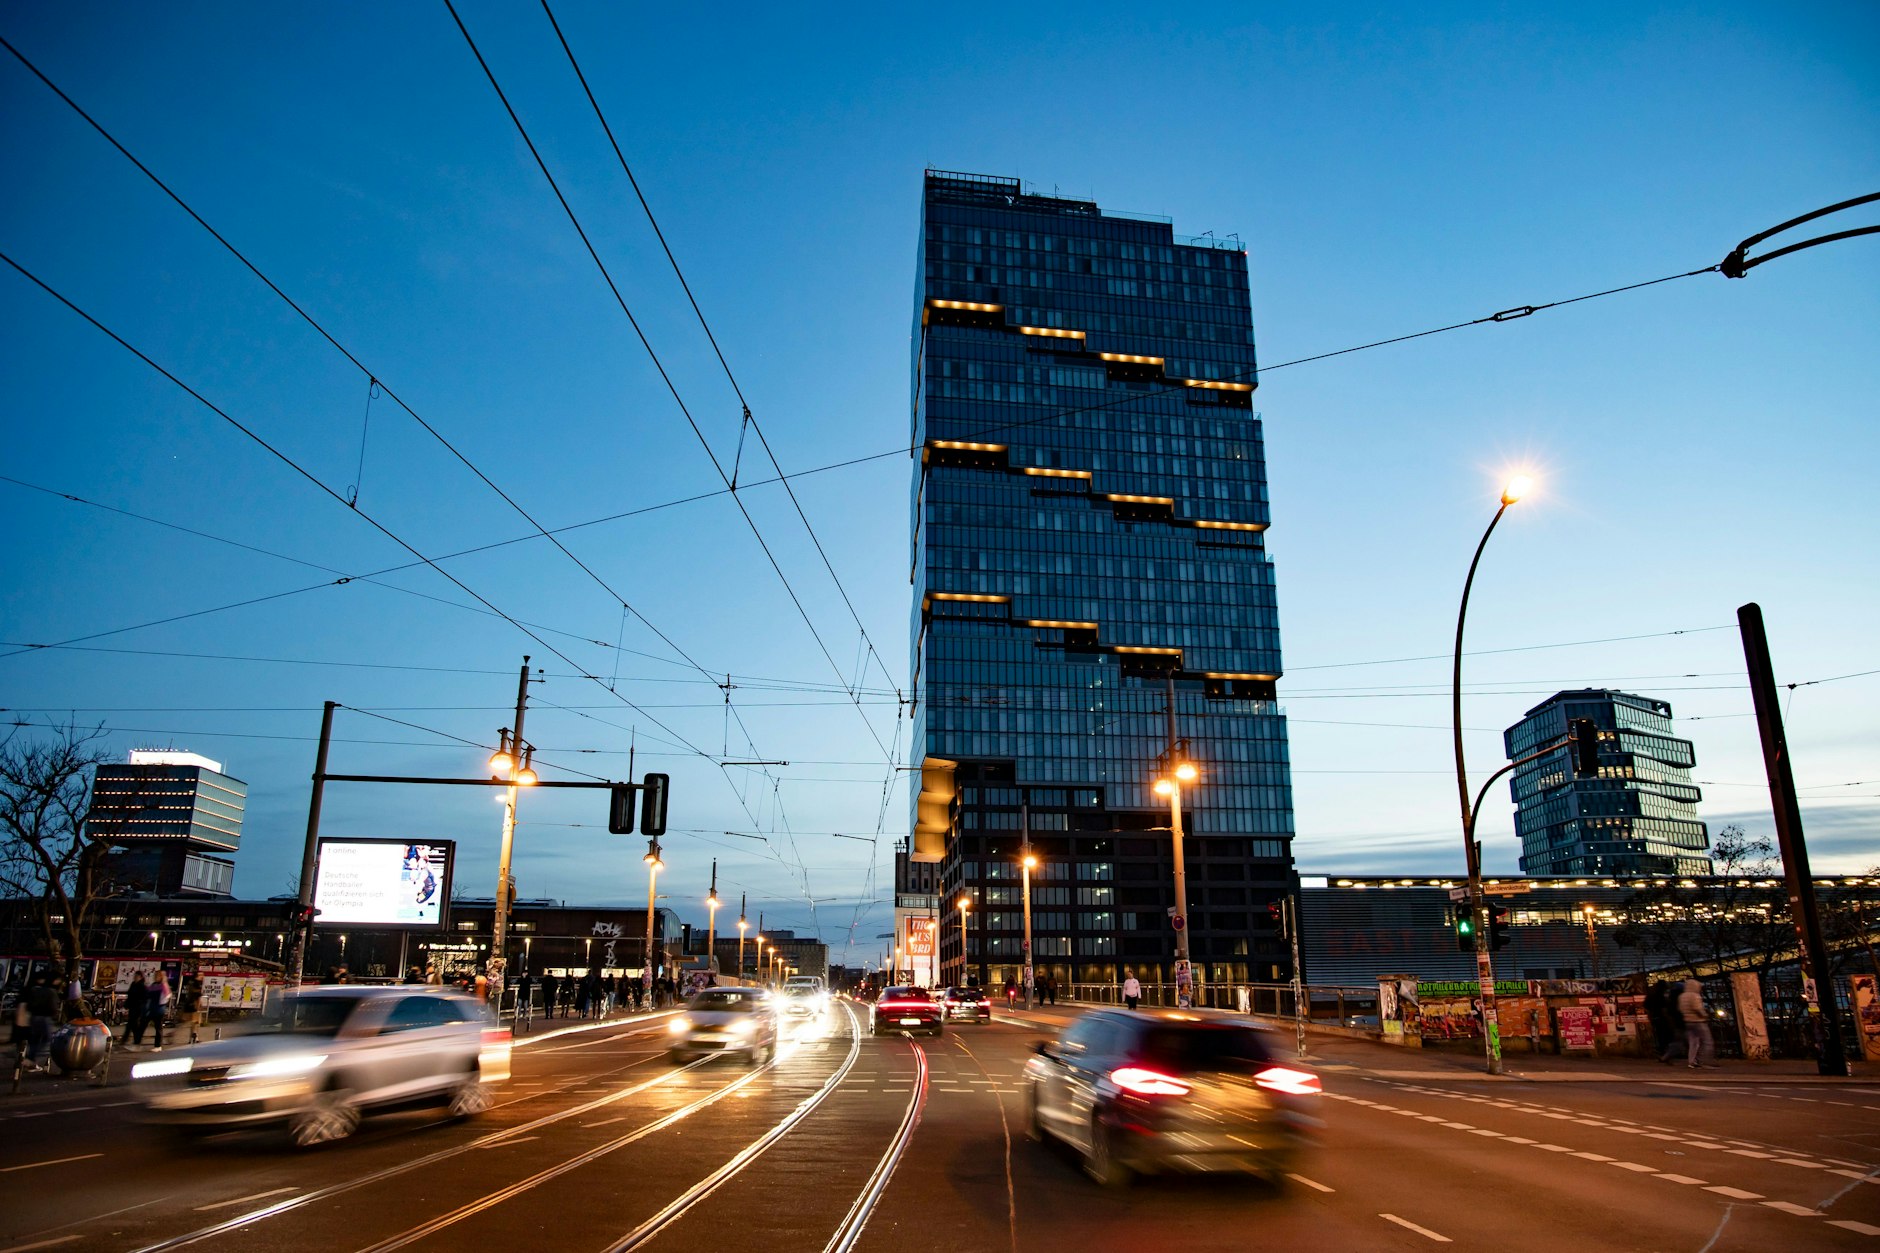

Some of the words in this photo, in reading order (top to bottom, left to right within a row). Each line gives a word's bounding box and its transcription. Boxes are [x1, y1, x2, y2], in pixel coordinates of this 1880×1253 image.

[324, 871, 359, 879] Deutsche
[322, 890, 367, 899] qualifizieren
[334, 899, 364, 908] Olympia
[912, 943, 931, 954] BRD
